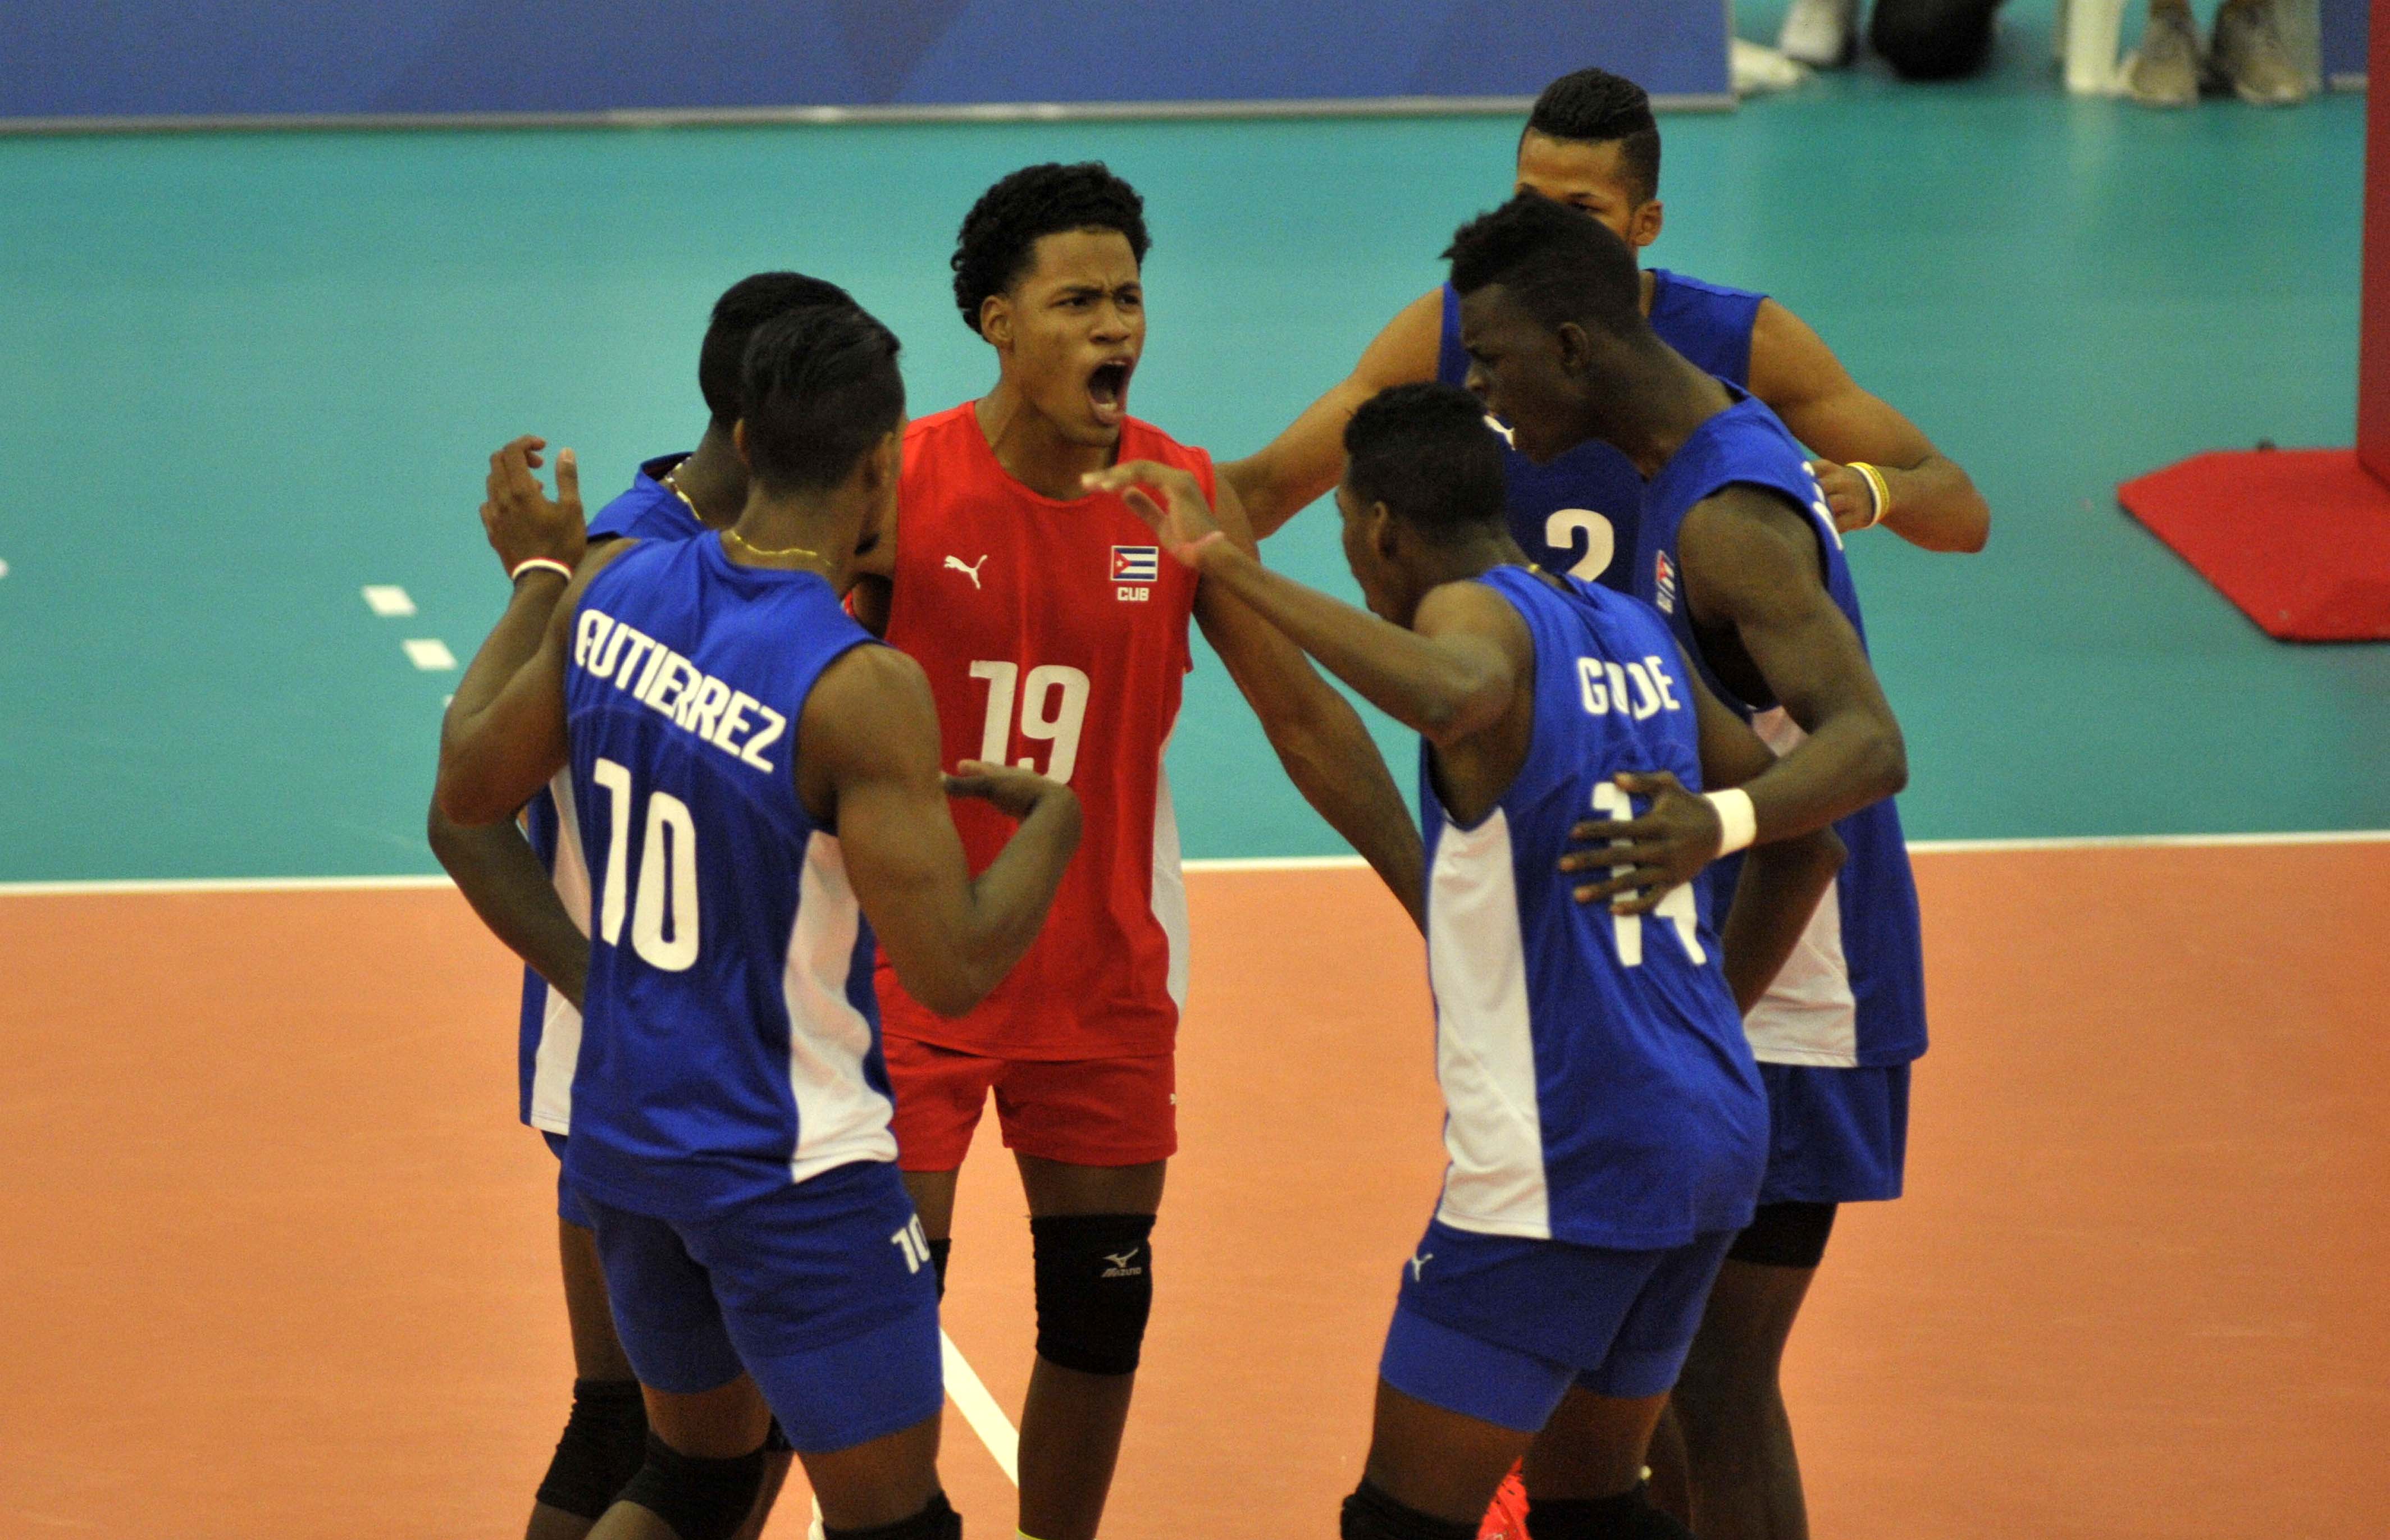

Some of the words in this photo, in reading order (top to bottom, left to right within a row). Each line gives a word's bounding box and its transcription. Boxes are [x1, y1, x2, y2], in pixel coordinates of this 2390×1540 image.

[1546, 509, 1614, 582] 2
[1117, 587, 1149, 601] CUB
[969, 660, 1090, 785] 19
[594, 758, 699, 971] 10
[891, 1213, 930, 1274] 10
